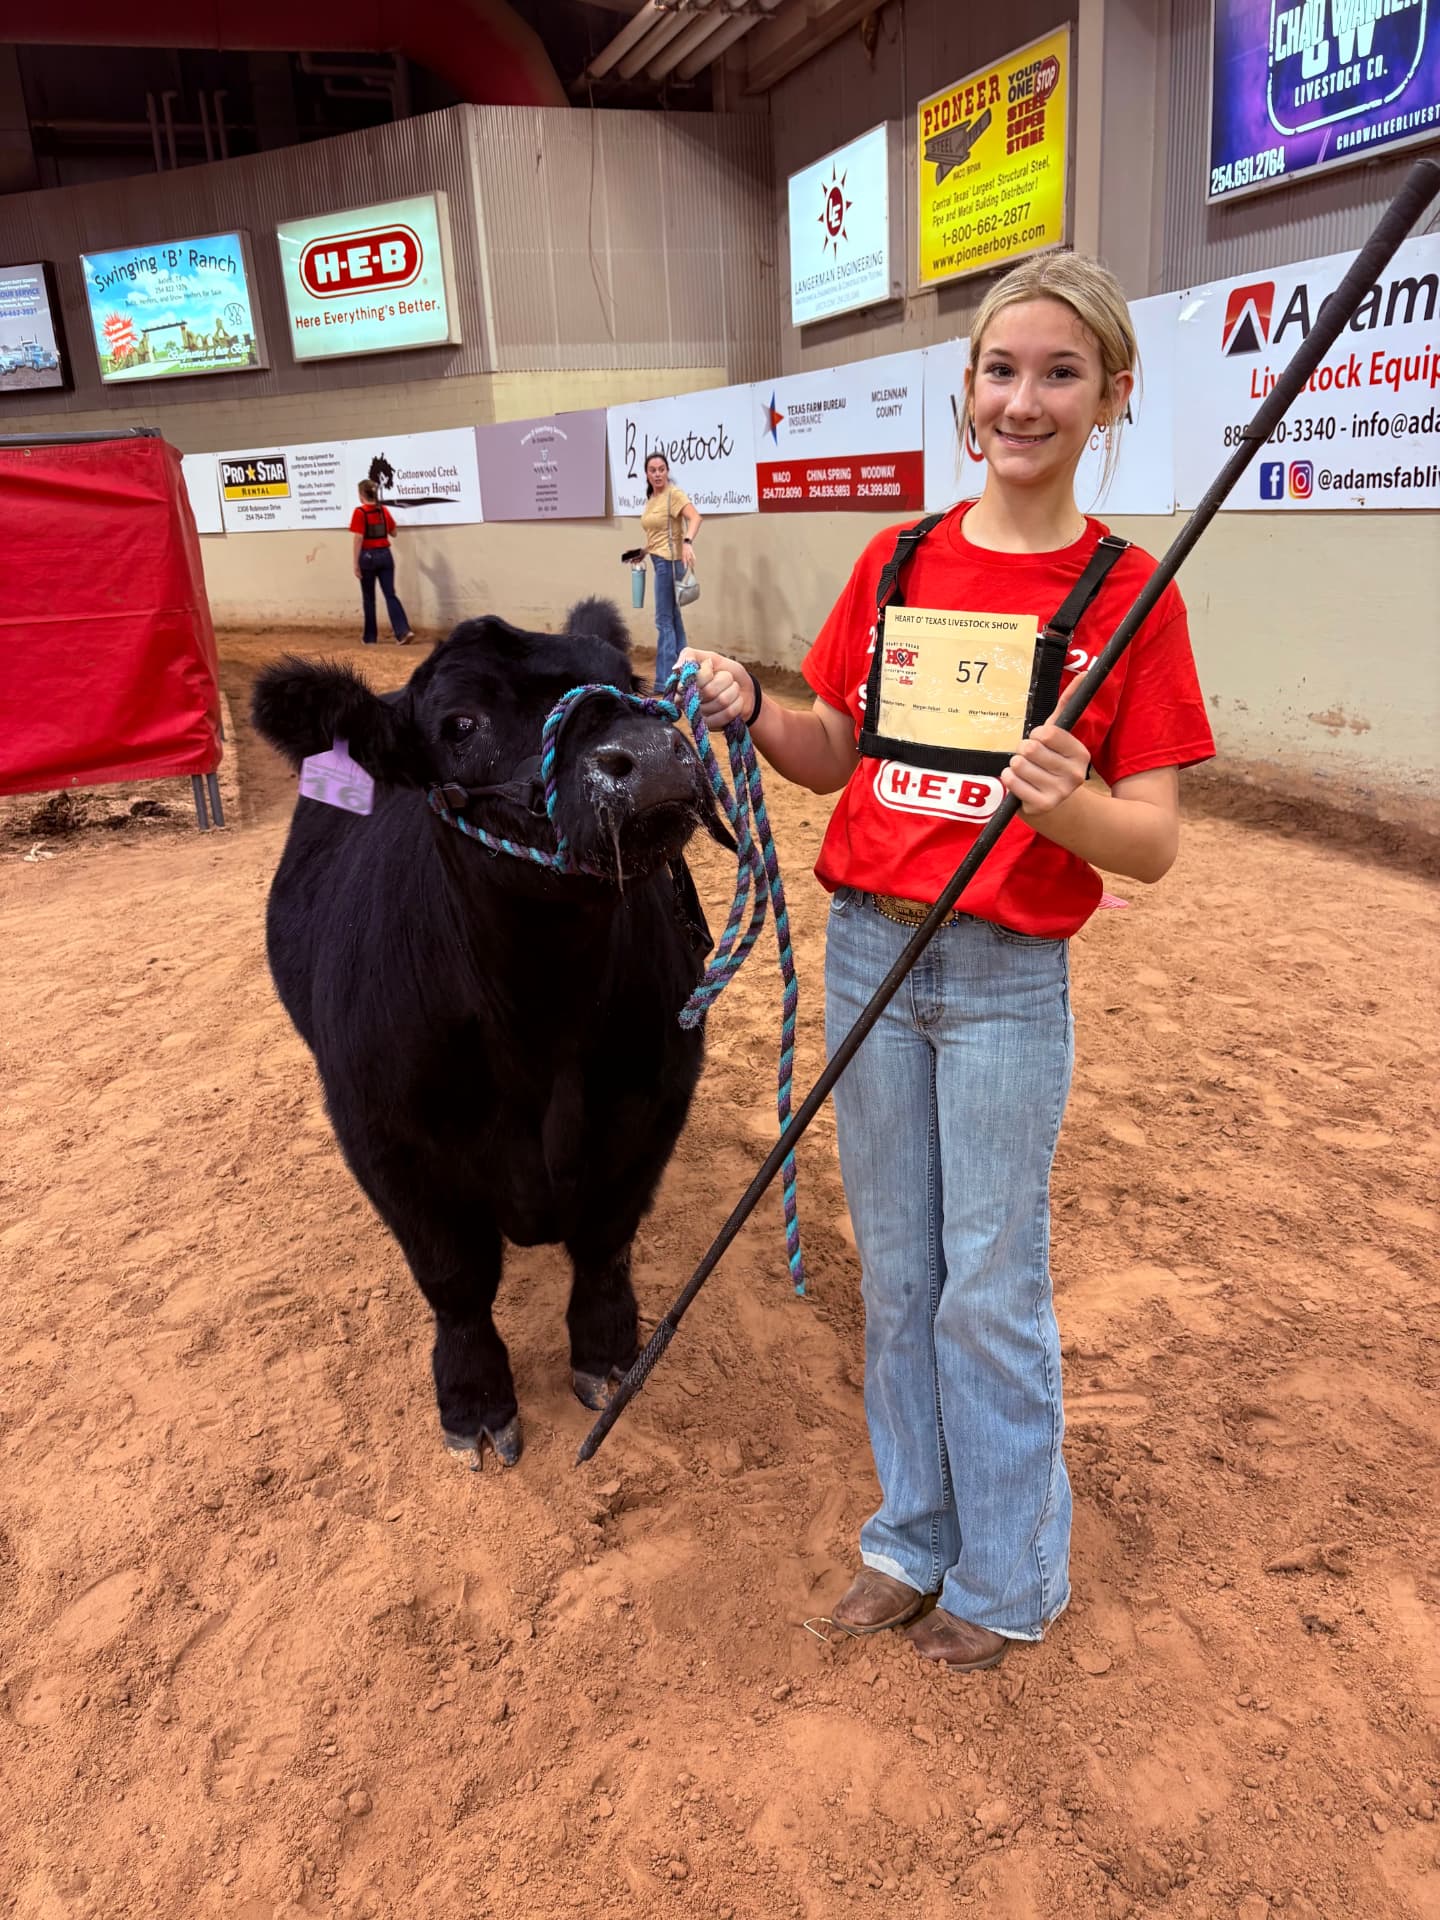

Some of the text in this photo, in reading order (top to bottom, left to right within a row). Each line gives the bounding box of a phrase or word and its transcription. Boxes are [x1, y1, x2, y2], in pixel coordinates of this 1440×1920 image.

[1275, 0, 1326, 61] CHAD
[1008, 60, 1042, 85] YOUR
[1008, 65, 1056, 103] ONE STOP
[1294, 54, 1388, 107] LIVESTOCK CO.
[924, 74, 1001, 136] PIONEER
[1006, 109, 1045, 139] SUPER
[1006, 126, 1045, 156] STORE
[1210, 146, 1285, 195] 254.631.2764
[932, 196, 950, 213] Central
[972, 178, 995, 198] Largest
[997, 163, 1029, 187] Structural
[946, 210, 956, 223] and
[958, 202, 973, 218] Metal
[975, 195, 999, 213] Building
[942, 202, 1031, 247] 1-800-662-2877
[933, 223, 1046, 270] www.pioneerboys.com
[95, 256, 158, 293] Swinging
[189, 249, 238, 274] Ranch
[795, 268, 835, 295] LANGERMAN
[837, 250, 883, 280] ENGINEERING
[295, 299, 441, 329] Here Everything's Better.
[1273, 273, 1440, 345] Aam
[1250, 353, 1363, 400] Livtock
[787, 397, 847, 416] TEXAS FARM BUREAU
[871, 386, 908, 402] MCLENNAN
[788, 413, 822, 428] INSURANCE
[876, 404, 902, 419] COUNTY
[222, 461, 285, 484] PRO STAR
[397, 465, 458, 481] Cottonwood Creek
[772, 472, 791, 483] WACO
[806, 468, 851, 482] CHINA SPRING
[860, 465, 896, 479] WOODWAY
[241, 488, 270, 496] RENTAL
[396, 481, 461, 496] Veterinary Hospital
[694, 491, 722, 508] Brinley
[723, 491, 752, 505] Allison
[894, 614, 915, 623] HEART
[926, 616, 947, 626] TEXAS
[948, 618, 990, 630] LIVESTOCK
[991, 621, 1019, 631] SHOW
[955, 660, 988, 684] 57
